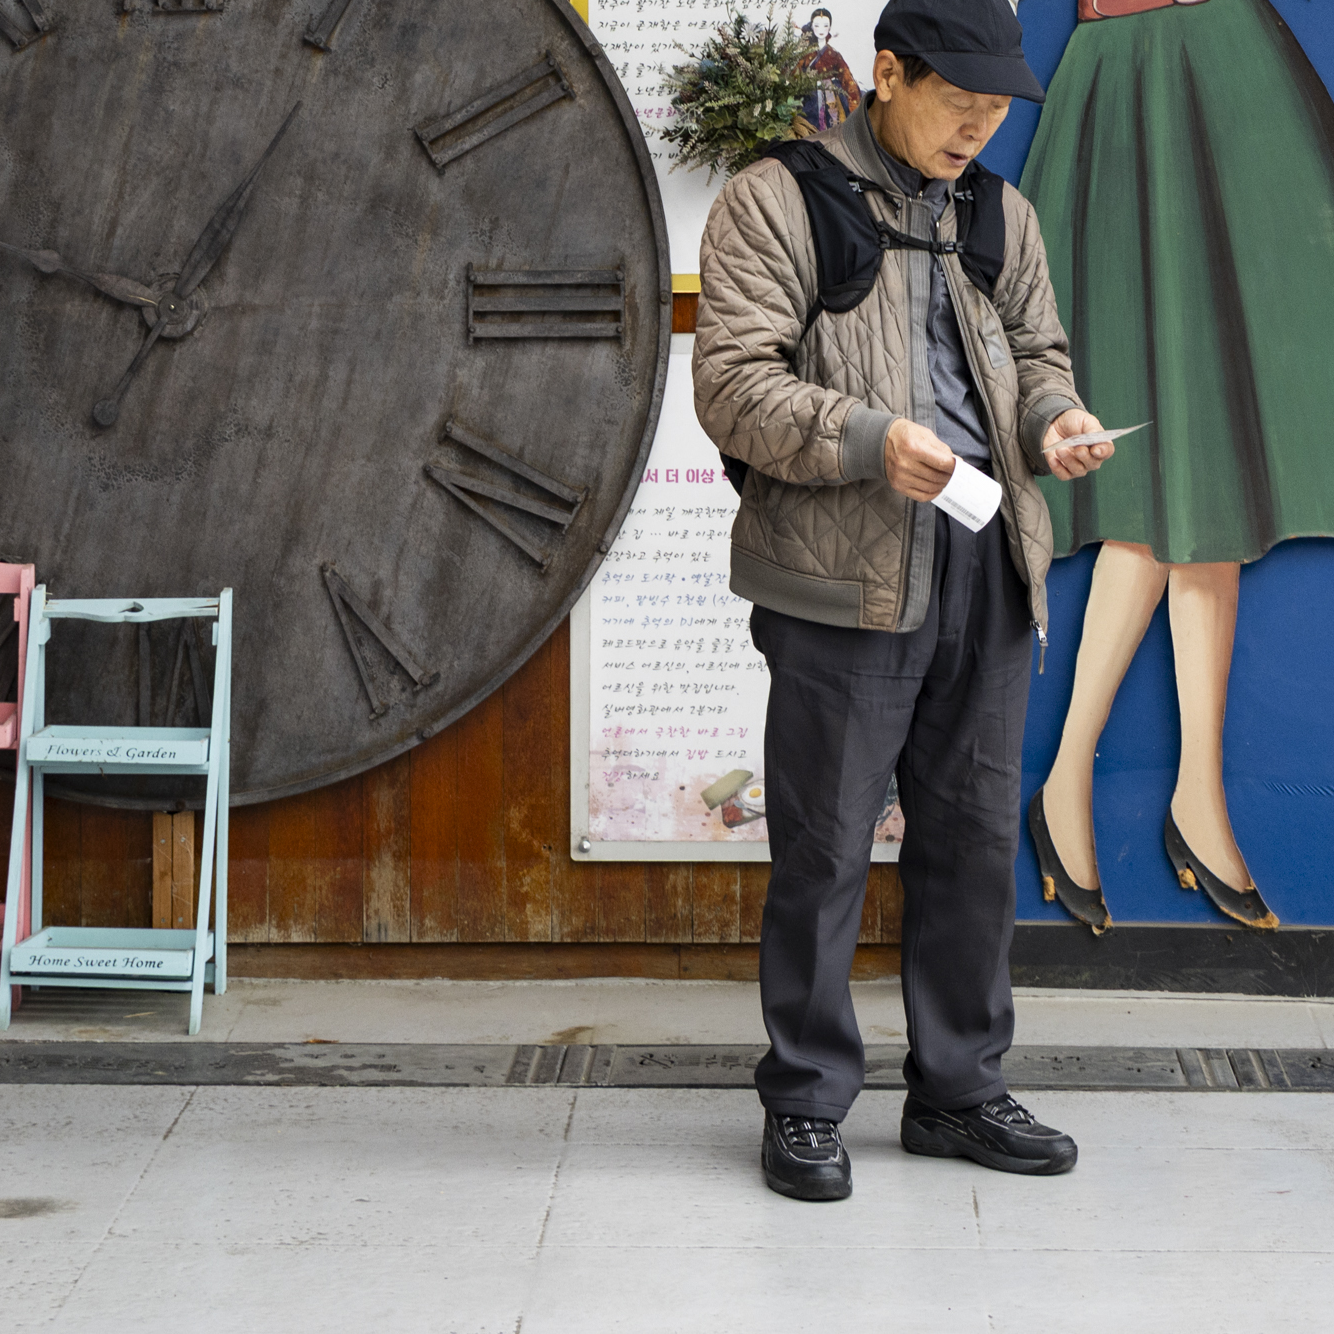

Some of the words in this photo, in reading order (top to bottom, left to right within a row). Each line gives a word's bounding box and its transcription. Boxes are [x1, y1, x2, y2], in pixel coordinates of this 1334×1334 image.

[665, 469, 680, 484] 더
[685, 468, 715, 484] 이상
[46, 745, 103, 758] Flowers
[106, 746, 122, 758] &
[126, 747, 177, 762] Garden
[28, 954, 71, 967] Home
[74, 955, 118, 968] Sweet
[122, 957, 164, 969] Home
